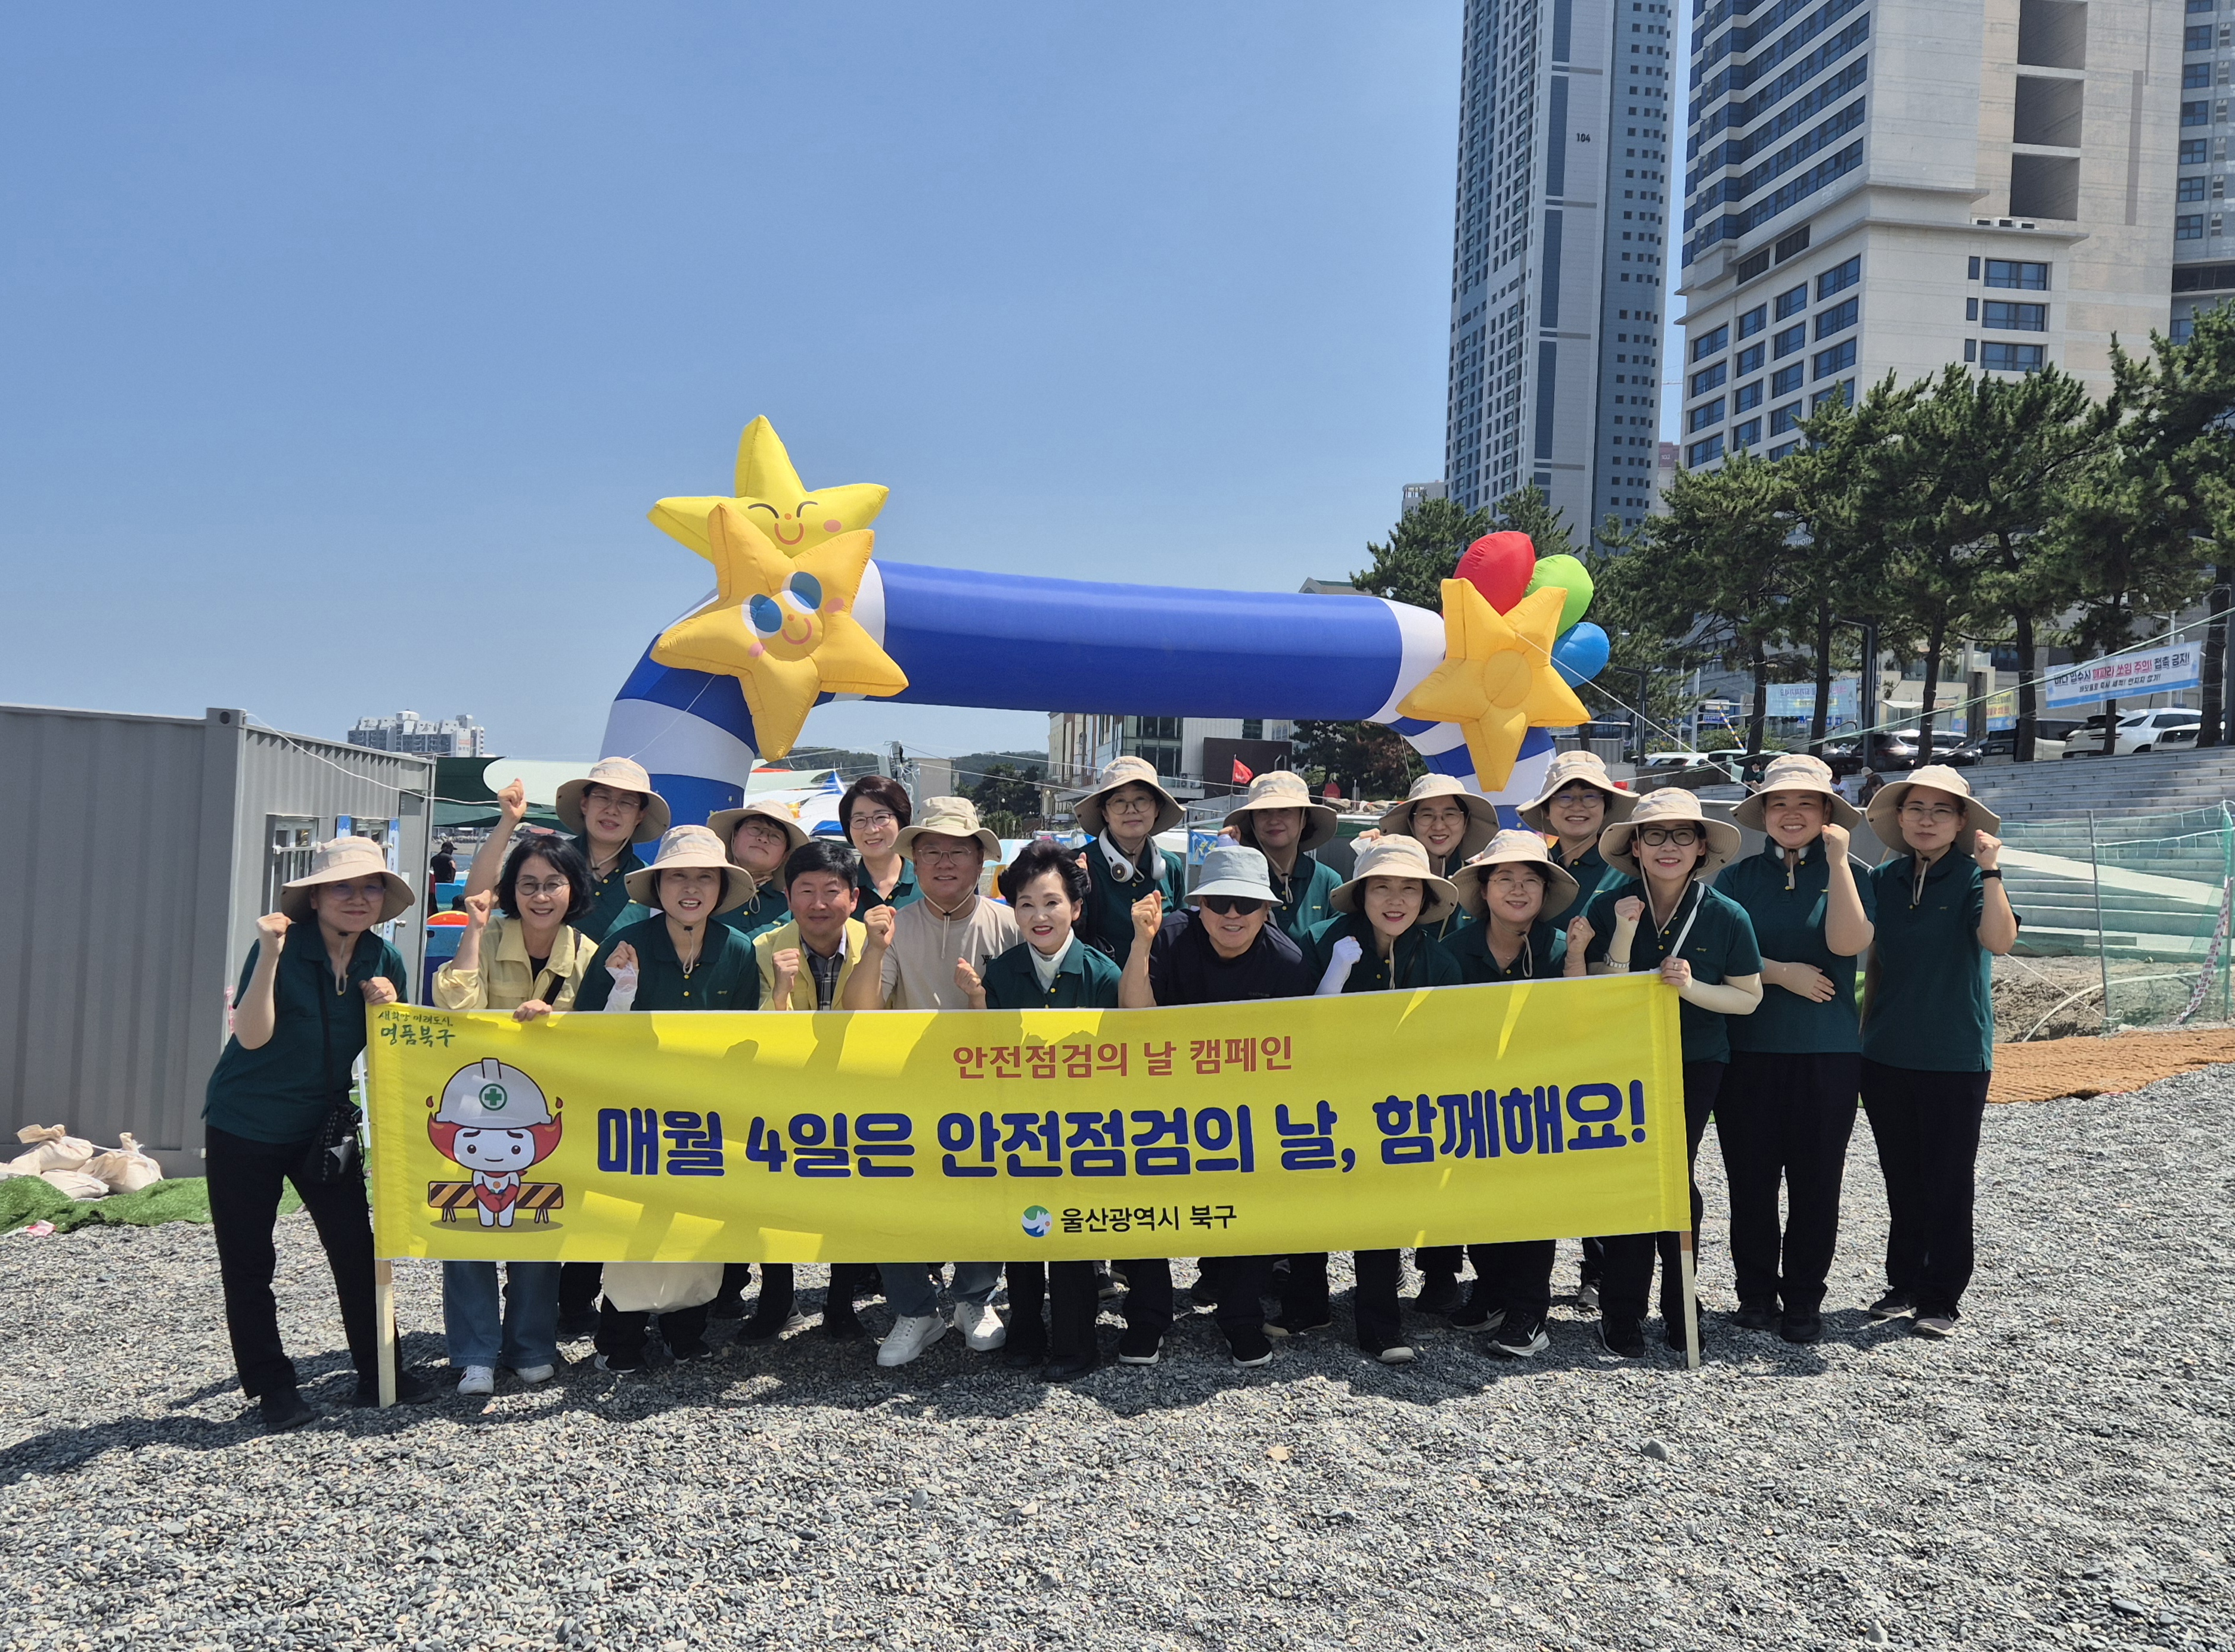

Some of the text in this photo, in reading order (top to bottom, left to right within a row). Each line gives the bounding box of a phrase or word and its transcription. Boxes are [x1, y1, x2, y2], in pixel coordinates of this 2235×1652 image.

[1576, 132, 1591, 142] 104
[2071, 669, 2091, 684] 입수시
[2093, 665, 2114, 680] 해파리
[2116, 663, 2132, 677] 쏘임
[2134, 659, 2152, 673] 주의!
[2154, 656, 2170, 671] 접촉
[2172, 652, 2190, 667] 금지!
[381, 1023, 455, 1048] 명품북구
[954, 1036, 1292, 1079] 안전점검의 날 캠페인
[598, 1079, 1646, 1178] 매월 4일은 안전점검의 날, 함께해요!
[1060, 1205, 1237, 1233] 울산광역시 북구
